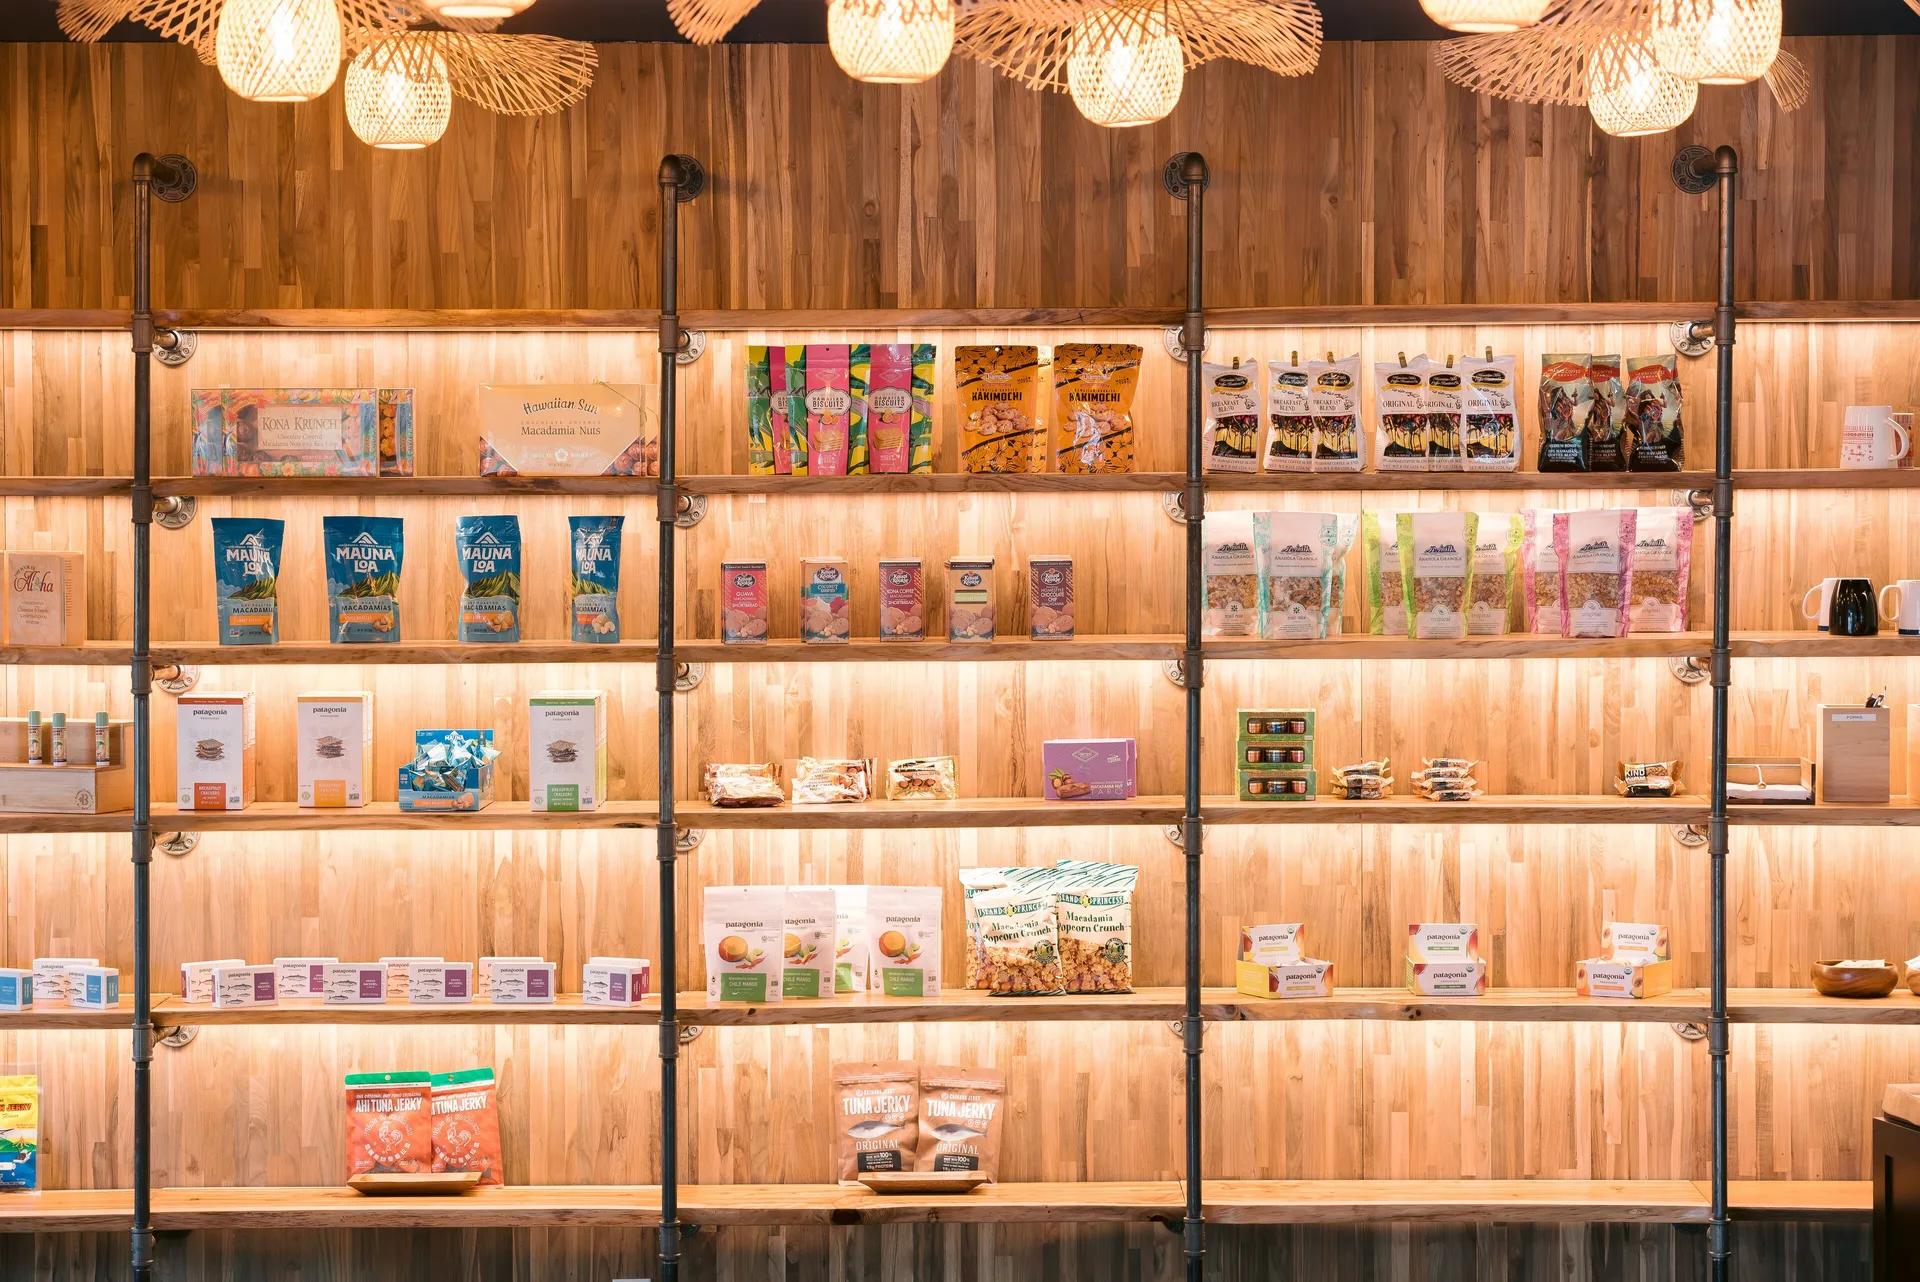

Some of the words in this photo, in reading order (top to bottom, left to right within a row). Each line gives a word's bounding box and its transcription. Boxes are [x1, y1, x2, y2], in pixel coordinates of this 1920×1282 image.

[972, 391, 1022, 401] KAKIMOCHI
[1069, 392, 1120, 402] KAKIMOCHI
[523, 397, 575, 415] Hawaiian
[577, 398, 599, 415] Sun
[812, 400, 844, 408] BISCUITS
[1382, 400, 1415, 408] ORIGINAL
[1467, 399, 1499, 407] ORIGINAL
[262, 416, 290, 431] KONA
[294, 416, 337, 431] KRUNCH
[521, 426, 575, 436] Macadamia
[579, 426, 601, 436] Nuts
[226, 549, 273, 564] MAUNA
[336, 547, 395, 560] MAUNA
[462, 547, 513, 560] MAUNA
[576, 548, 612, 561] MAUNA
[243, 562, 263, 576] LOA
[354, 560, 379, 573] LOA
[473, 560, 496, 573] LOA
[581, 561, 597, 574] LOA
[1431, 615, 1451, 623] tropical
[1471, 612, 1491, 620] tropical
[193, 709, 227, 717] patagonia
[312, 706, 347, 714] patagonia
[545, 709, 580, 717] patagonia
[1625, 769, 1645, 777] KIND
[1091, 896, 1124, 906] PRINCESS
[979, 906, 1003, 917] ISLAND
[1066, 911, 1113, 922] Macadamia
[725, 920, 763, 929] patagonia
[885, 915, 921, 924] patagonia
[1020, 926, 1051, 938] Crunch
[1057, 923, 1091, 933] Popcorn
[1093, 923, 1125, 933] Crunch
[1258, 933, 1289, 942] patagonia
[1427, 933, 1461, 941] patagonia
[1618, 933, 1650, 941] patagonia
[1286, 972, 1317, 981] patagonia
[1433, 971, 1467, 979] patagonia
[1592, 972, 1625, 980] patagonia
[6, 1102, 32, 1112] JERKY
[355, 1098, 370, 1113] AHI
[371, 1098, 394, 1113] TUNA
[394, 1097, 423, 1112] JERKY
[435, 1099, 460, 1115] TUNA
[459, 1096, 487, 1111] JERKY
[842, 1096, 873, 1116] TUNA
[874, 1095, 911, 1114] JERKY
[926, 1099, 957, 1118] TUNA
[957, 1102, 996, 1120] JERKY
[855, 1139, 900, 1151] ORIGINAL
[936, 1142, 980, 1155] ORIGINAL
